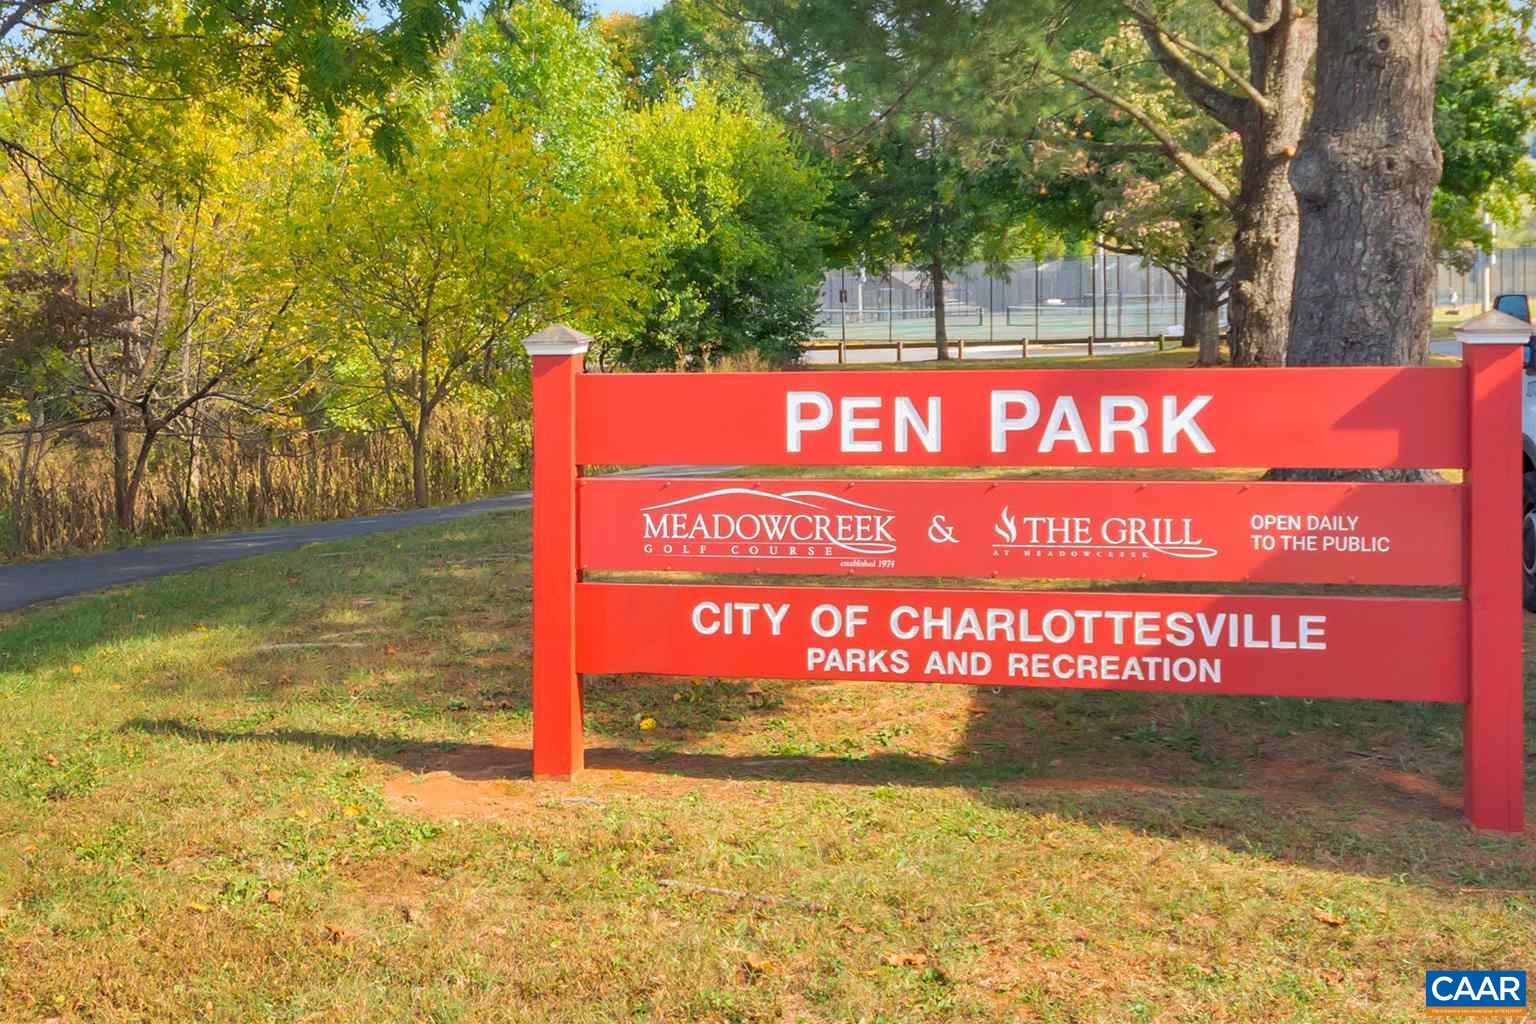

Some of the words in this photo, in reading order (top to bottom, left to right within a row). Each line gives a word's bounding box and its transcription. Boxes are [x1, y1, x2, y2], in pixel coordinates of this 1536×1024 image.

[785, 390, 942, 453] PEN
[990, 389, 1216, 454] PARK
[642, 513, 897, 543] MEADOWCREEK
[927, 514, 960, 544] &
[1023, 517, 1093, 544] THE
[1101, 517, 1203, 545] GRILL
[1250, 514, 1302, 531] OPEN
[1307, 515, 1359, 531] DAILY
[643, 543, 707, 554] GOLF
[730, 545, 833, 556] COURSE
[1250, 535, 1276, 551] TO
[1280, 535, 1318, 551] THE
[1322, 536, 1391, 553] PUBLIC
[691, 601, 791, 636] CITY
[810, 603, 870, 639] OF
[889, 605, 1328, 650] CHARLOTTESVILLE
[806, 647, 911, 674] PARKS
[923, 650, 993, 677] AND
[1007, 652, 1222, 684] RECREATION
